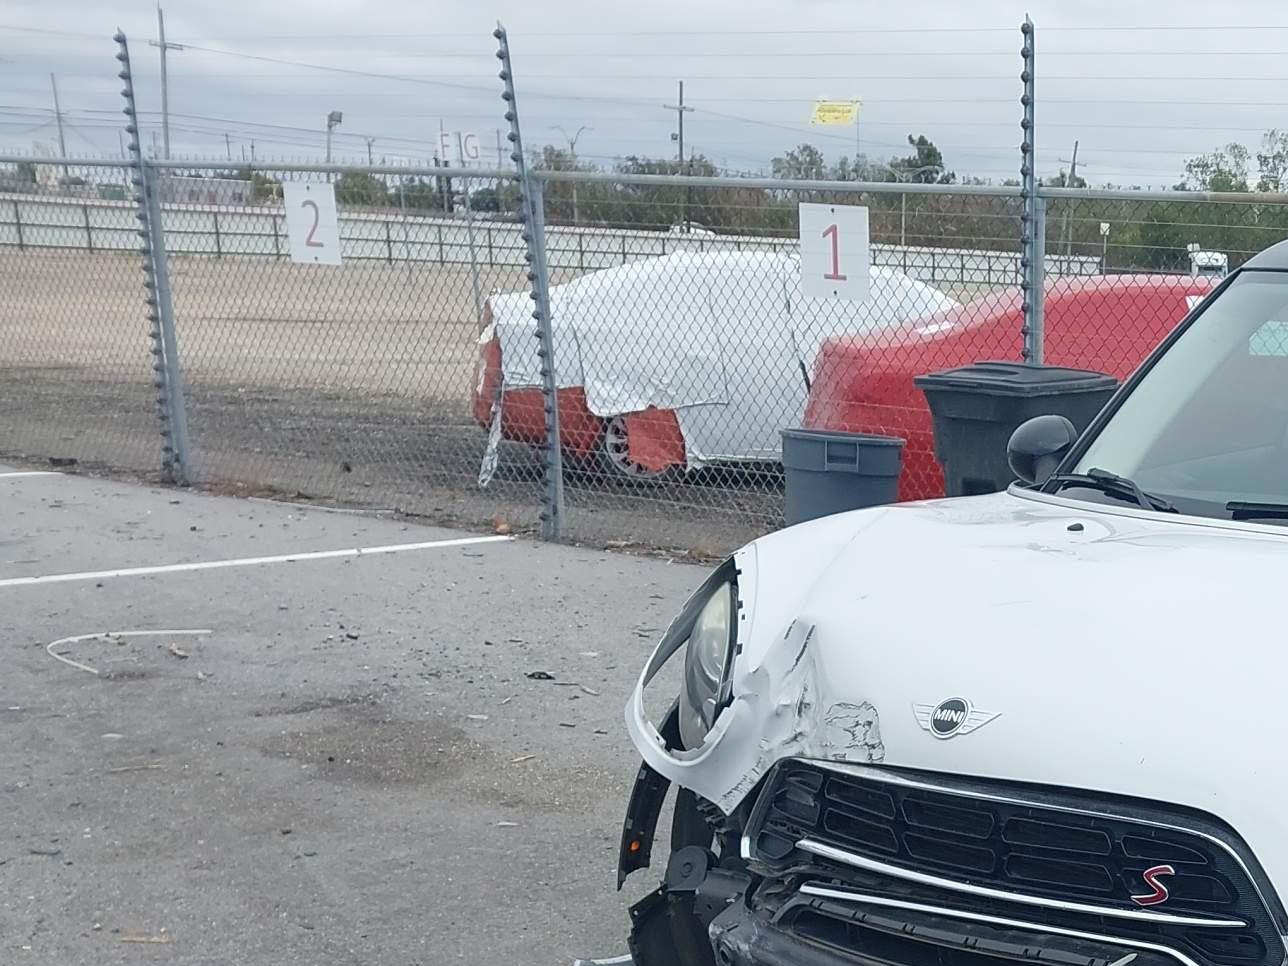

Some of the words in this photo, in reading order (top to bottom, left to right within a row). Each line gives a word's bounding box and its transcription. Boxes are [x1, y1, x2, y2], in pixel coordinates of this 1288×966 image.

[464, 134, 479, 159] G
[302, 200, 324, 248] 2
[822, 224, 847, 281] 1
[934, 708, 965, 723] MINI
[1130, 864, 1176, 906] S
